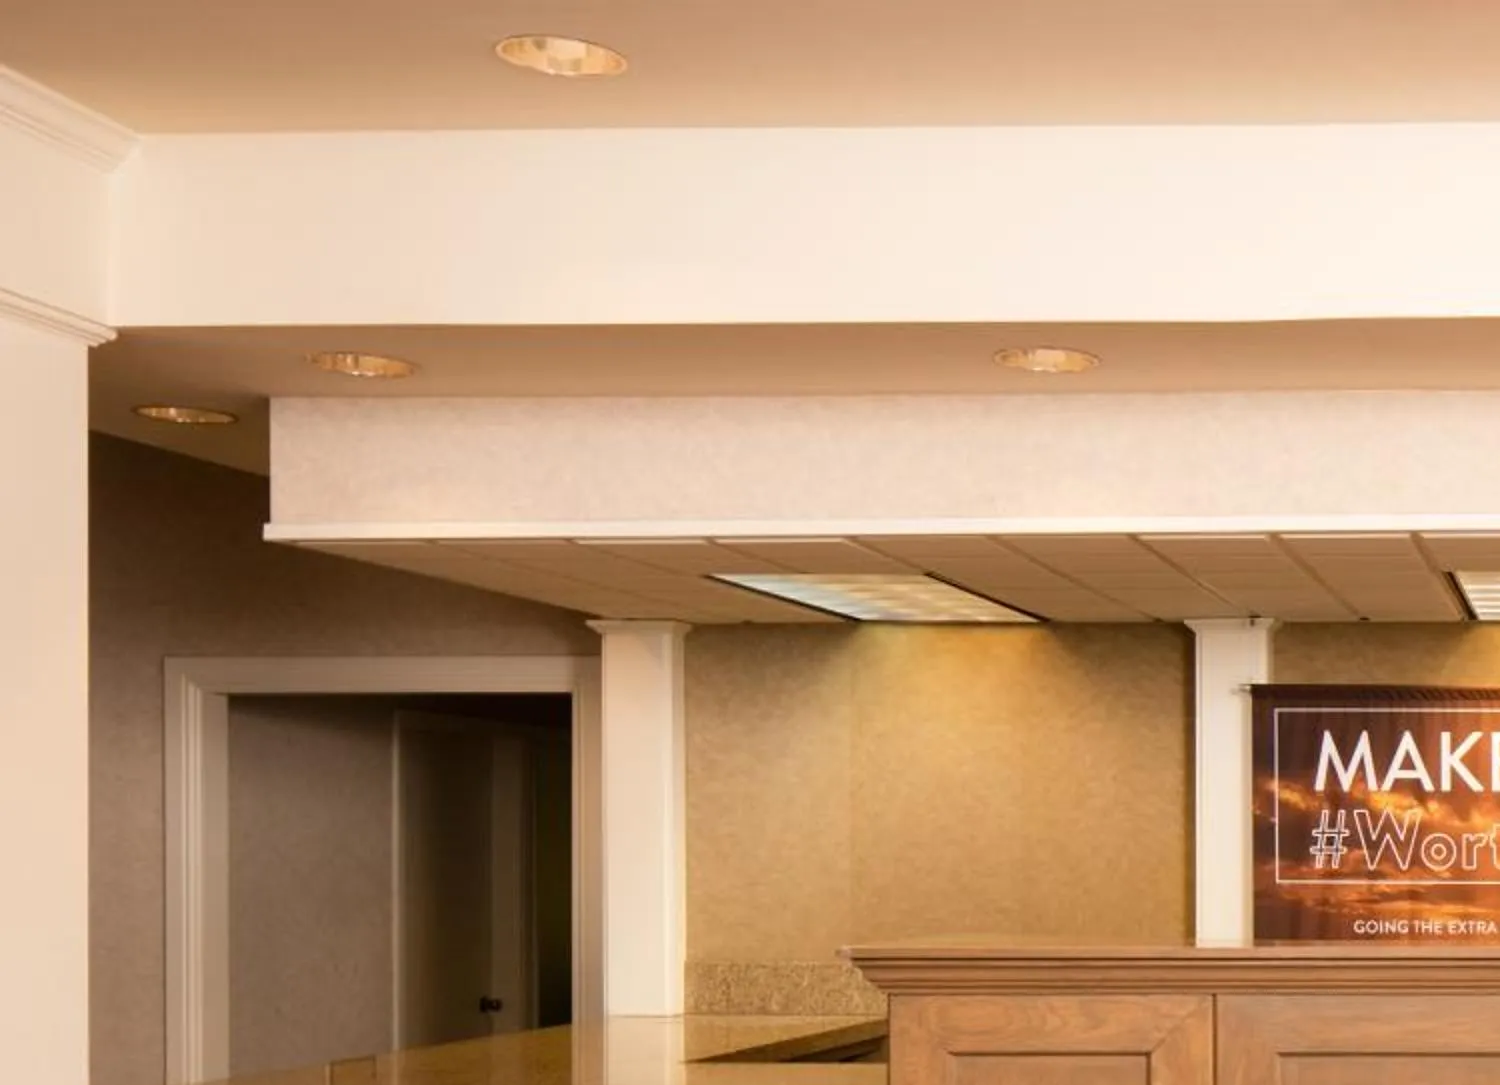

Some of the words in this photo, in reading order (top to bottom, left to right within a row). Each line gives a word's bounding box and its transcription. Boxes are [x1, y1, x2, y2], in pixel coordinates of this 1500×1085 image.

[1353, 919, 1409, 935] GOING
[1412, 919, 1443, 935] THE
[1448, 920, 1498, 935] EXTRA
